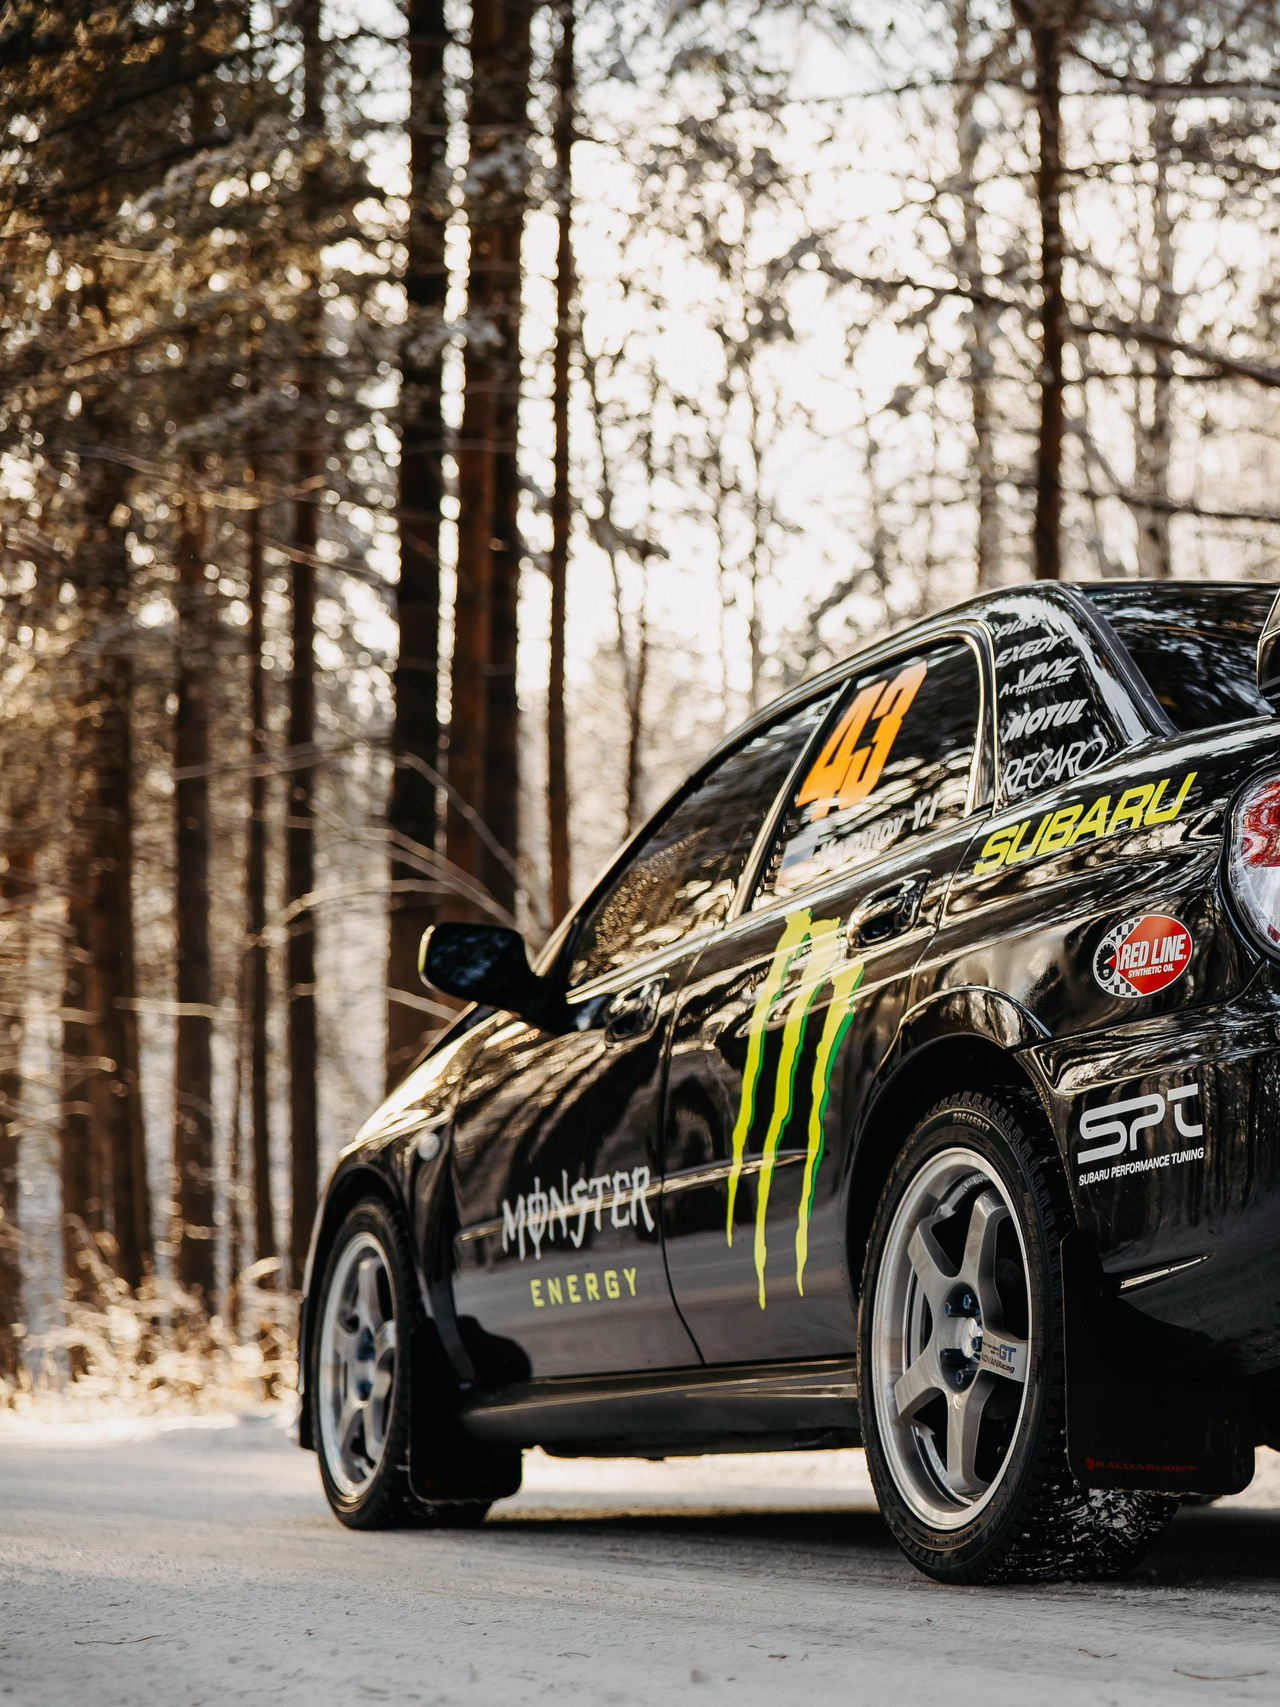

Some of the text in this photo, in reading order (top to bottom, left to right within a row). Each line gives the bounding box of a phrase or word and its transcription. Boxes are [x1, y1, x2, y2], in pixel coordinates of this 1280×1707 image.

[995, 633, 1071, 669] EXEDY
[1018, 655, 1080, 688] VINYL
[1002, 698, 1088, 743] MOTUL
[795, 660, 928, 823] 43
[997, 737, 1108, 800] RECARO
[973, 771, 1198, 875] SUBARU
[1120, 940, 1150, 970] RED
[1127, 963, 1175, 979] SYNTHETIC OIL
[1077, 1083, 1204, 1165] SPT
[1078, 1147, 1205, 1187] SUBARU PERFORMANCE TUNING
[502, 1165, 655, 1262] MONSTER
[529, 1267, 637, 1308] ENERGY
[999, 1343, 1017, 1363] GT
